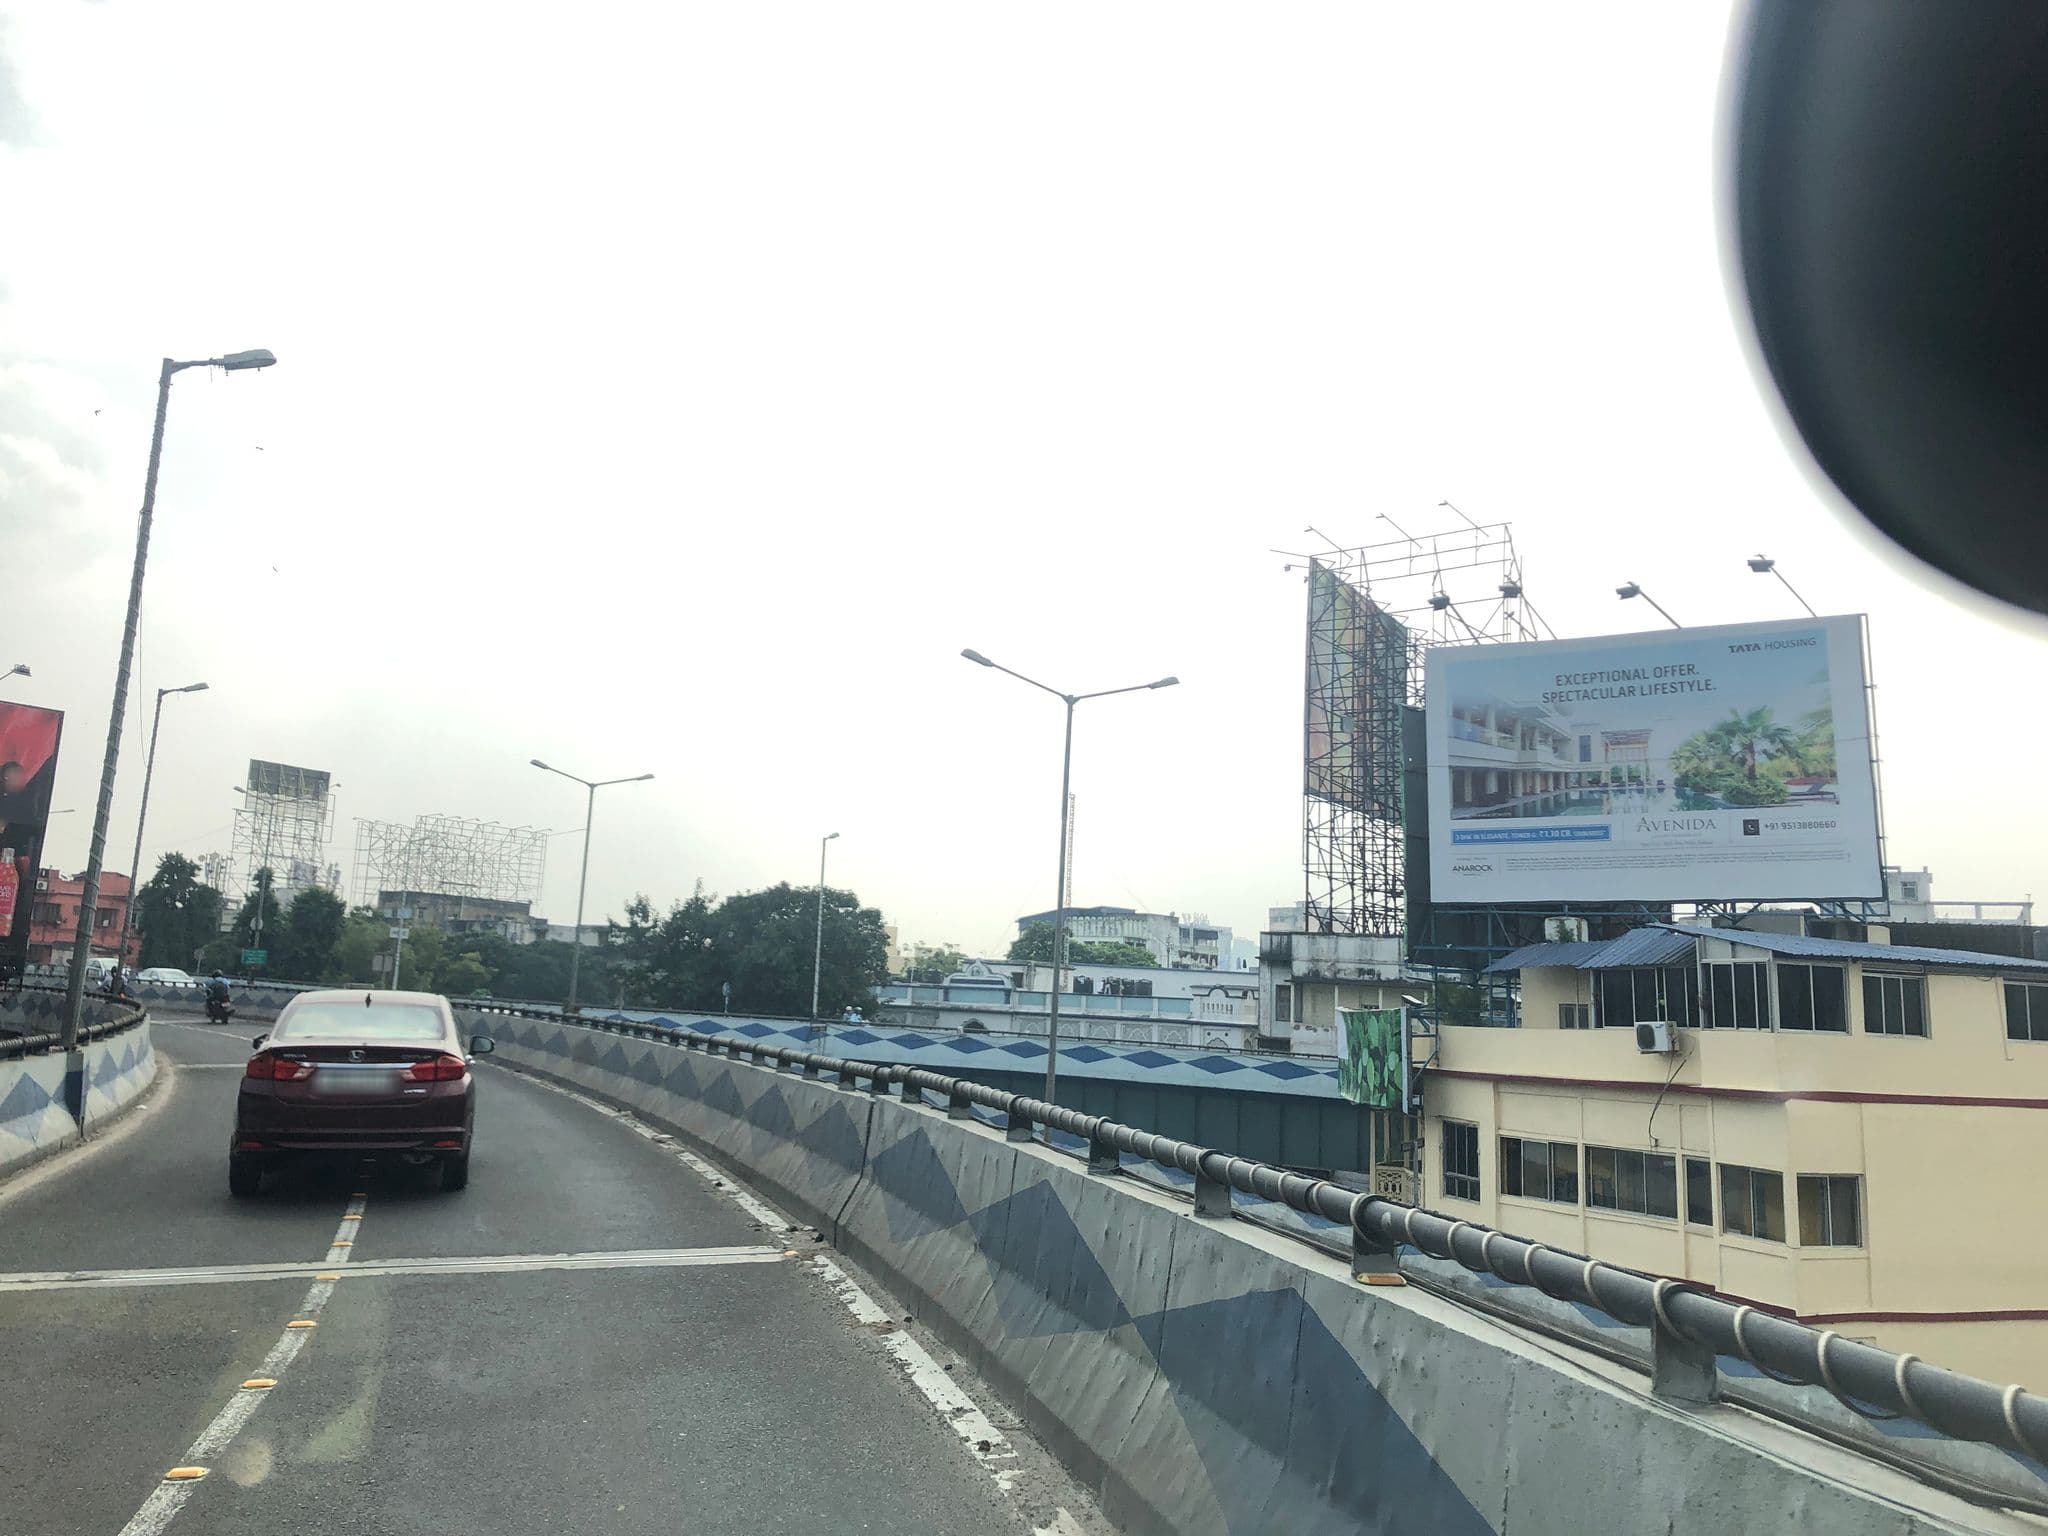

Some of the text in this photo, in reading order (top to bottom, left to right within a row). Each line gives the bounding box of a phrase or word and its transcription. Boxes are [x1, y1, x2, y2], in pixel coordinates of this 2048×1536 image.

[1728, 637, 1817, 654] TATA HOUSING
[1555, 663, 1700, 687] EXCEPTIONAL OFFER.
[1542, 678, 1717, 704] SPECTACULAR LIFESTYLE.
[1452, 864, 1493, 873] ANAROCK
